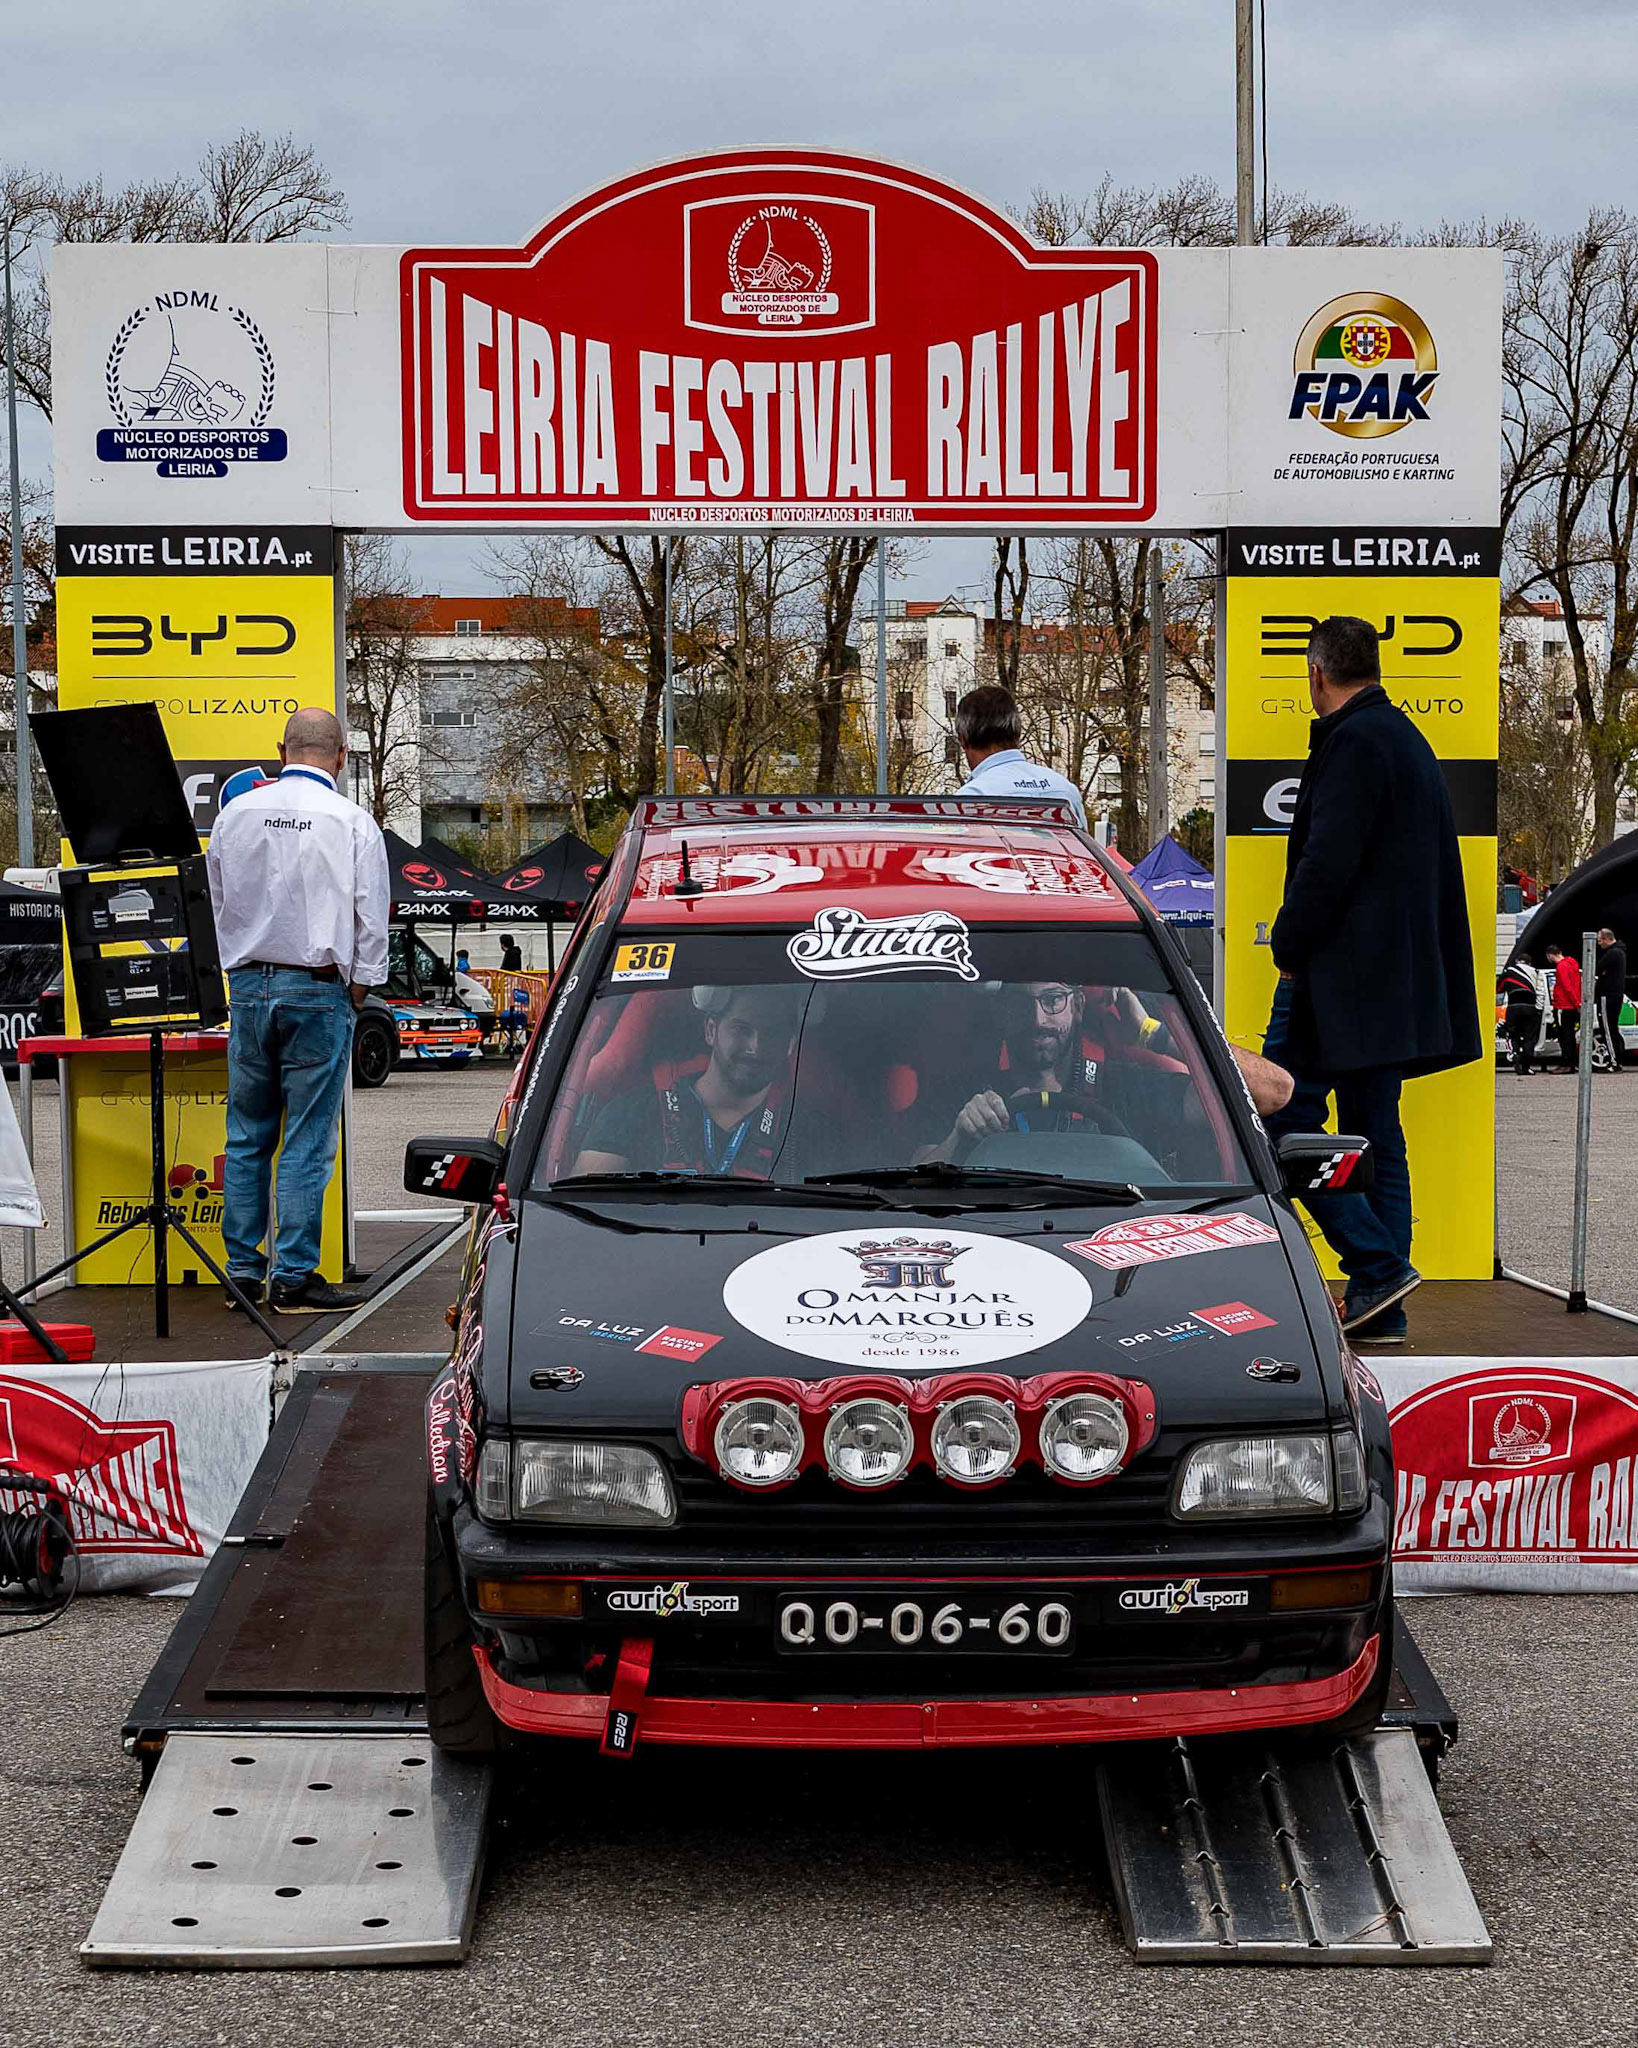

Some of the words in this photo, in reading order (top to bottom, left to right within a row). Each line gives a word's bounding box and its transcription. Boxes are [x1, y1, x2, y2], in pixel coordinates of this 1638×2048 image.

[758, 206, 799, 221] NDML
[154, 290, 220, 312] NDML
[772, 294, 828, 302] DESPORTOS
[740, 304, 806, 312] MOTORIZADOS
[808, 304, 821, 312] DE
[765, 314, 795, 322] LEIRIA
[430, 275, 619, 496] LEIRIA
[639, 350, 906, 498] FESTIVAL
[927, 276, 1131, 498] RALLYE
[1288, 372, 1440, 421] FPAK
[113, 429, 175, 444] NÚCLEO
[178, 431, 270, 444] DESPORTOS
[125, 447, 234, 460] MOTORIZADOS
[237, 447, 259, 460] DE
[1288, 451, 1358, 466] FEDERAÇÃO
[1361, 453, 1440, 465] PORTUGUESA
[168, 463, 217, 475] LEIRIA
[1273, 468, 1290, 480] DE
[1291, 468, 1390, 480] AUTOMOBILISMO
[1392, 468, 1401, 480] E
[1402, 468, 1456, 480] KARTING
[700, 508, 769, 521] DESPORTOS
[771, 508, 856, 521] MOTORIZADOS
[858, 508, 875, 521] DE
[876, 508, 915, 521] LEIRIA
[69, 543, 154, 565] VISITE
[1241, 544, 1325, 566] VISITE
[92, 614, 297, 656] BYD
[264, 817, 312, 832] ndml.pt
[9, 903, 53, 918] HISTORIC
[397, 903, 451, 916] 24MX
[487, 903, 539, 917] 24MX
[788, 908, 972, 972] Stache
[628, 945, 669, 970] 36
[1139, 1221, 1177, 1237] 36
[1139, 1230, 1222, 1258] FESTIVAL
[797, 1288, 840, 1309] O
[847, 1292, 1019, 1306] MANJAR
[1213, 1309, 1251, 1323] RACING
[1223, 1314, 1256, 1326] PARTS
[558, 1316, 594, 1328] DA
[597, 1322, 645, 1337] LUZ
[1117, 1332, 1153, 1347] DA
[1153, 1320, 1199, 1337] LUZ
[659, 1341, 697, 1352] PARTS
[661, 1335, 705, 1348] RACING
[861, 1347, 910, 1357] desde
[918, 1347, 960, 1357] 1986
[1511, 1397, 1534, 1407] NDML
[1430, 1472, 1577, 1548] FESTIVAL
[1460, 1555, 1500, 1563] DESPORTOS
[1500, 1555, 1548, 1563] MOTORIZADOS
[1548, 1555, 1558, 1563] DE
[609, 1583, 688, 1612] auriol
[691, 1597, 738, 1616] sport
[1120, 1580, 1199, 1609] auriol
[1202, 1592, 1248, 1610] sport
